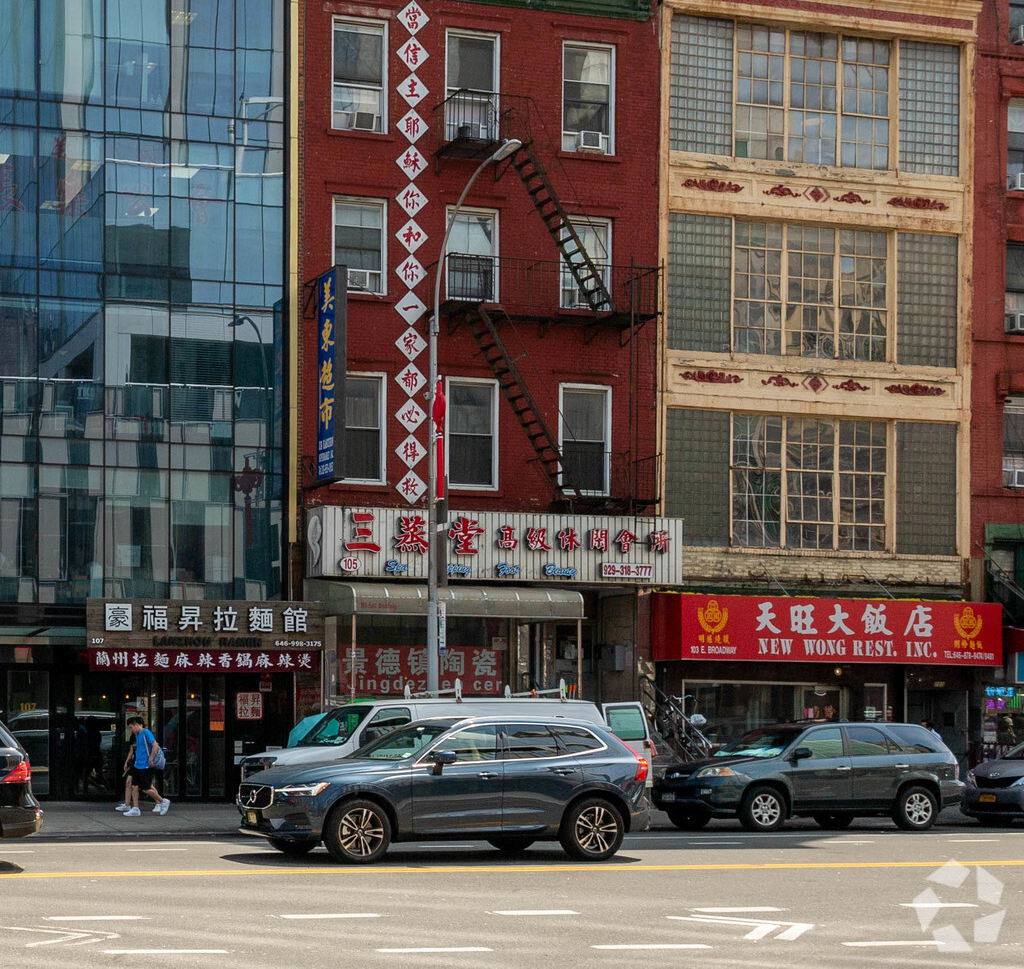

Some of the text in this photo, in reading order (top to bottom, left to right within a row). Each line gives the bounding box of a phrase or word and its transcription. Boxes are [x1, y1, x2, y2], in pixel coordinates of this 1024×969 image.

[344, 558, 358, 570] 105
[386, 560, 408, 574] Spa
[497, 563, 520, 577] Foot
[545, 564, 576, 579] Beauty
[603, 564, 652, 576] 929-318-3777
[756, 601, 933, 637] 天旺大飯店
[707, 646, 737, 655] BROADWAY
[758, 638, 793, 655] NEW
[803, 639, 846, 656] WONG
[852, 639, 898, 657] REST.
[906, 641, 938, 658] INC.
[20, 702, 37, 711] 107
